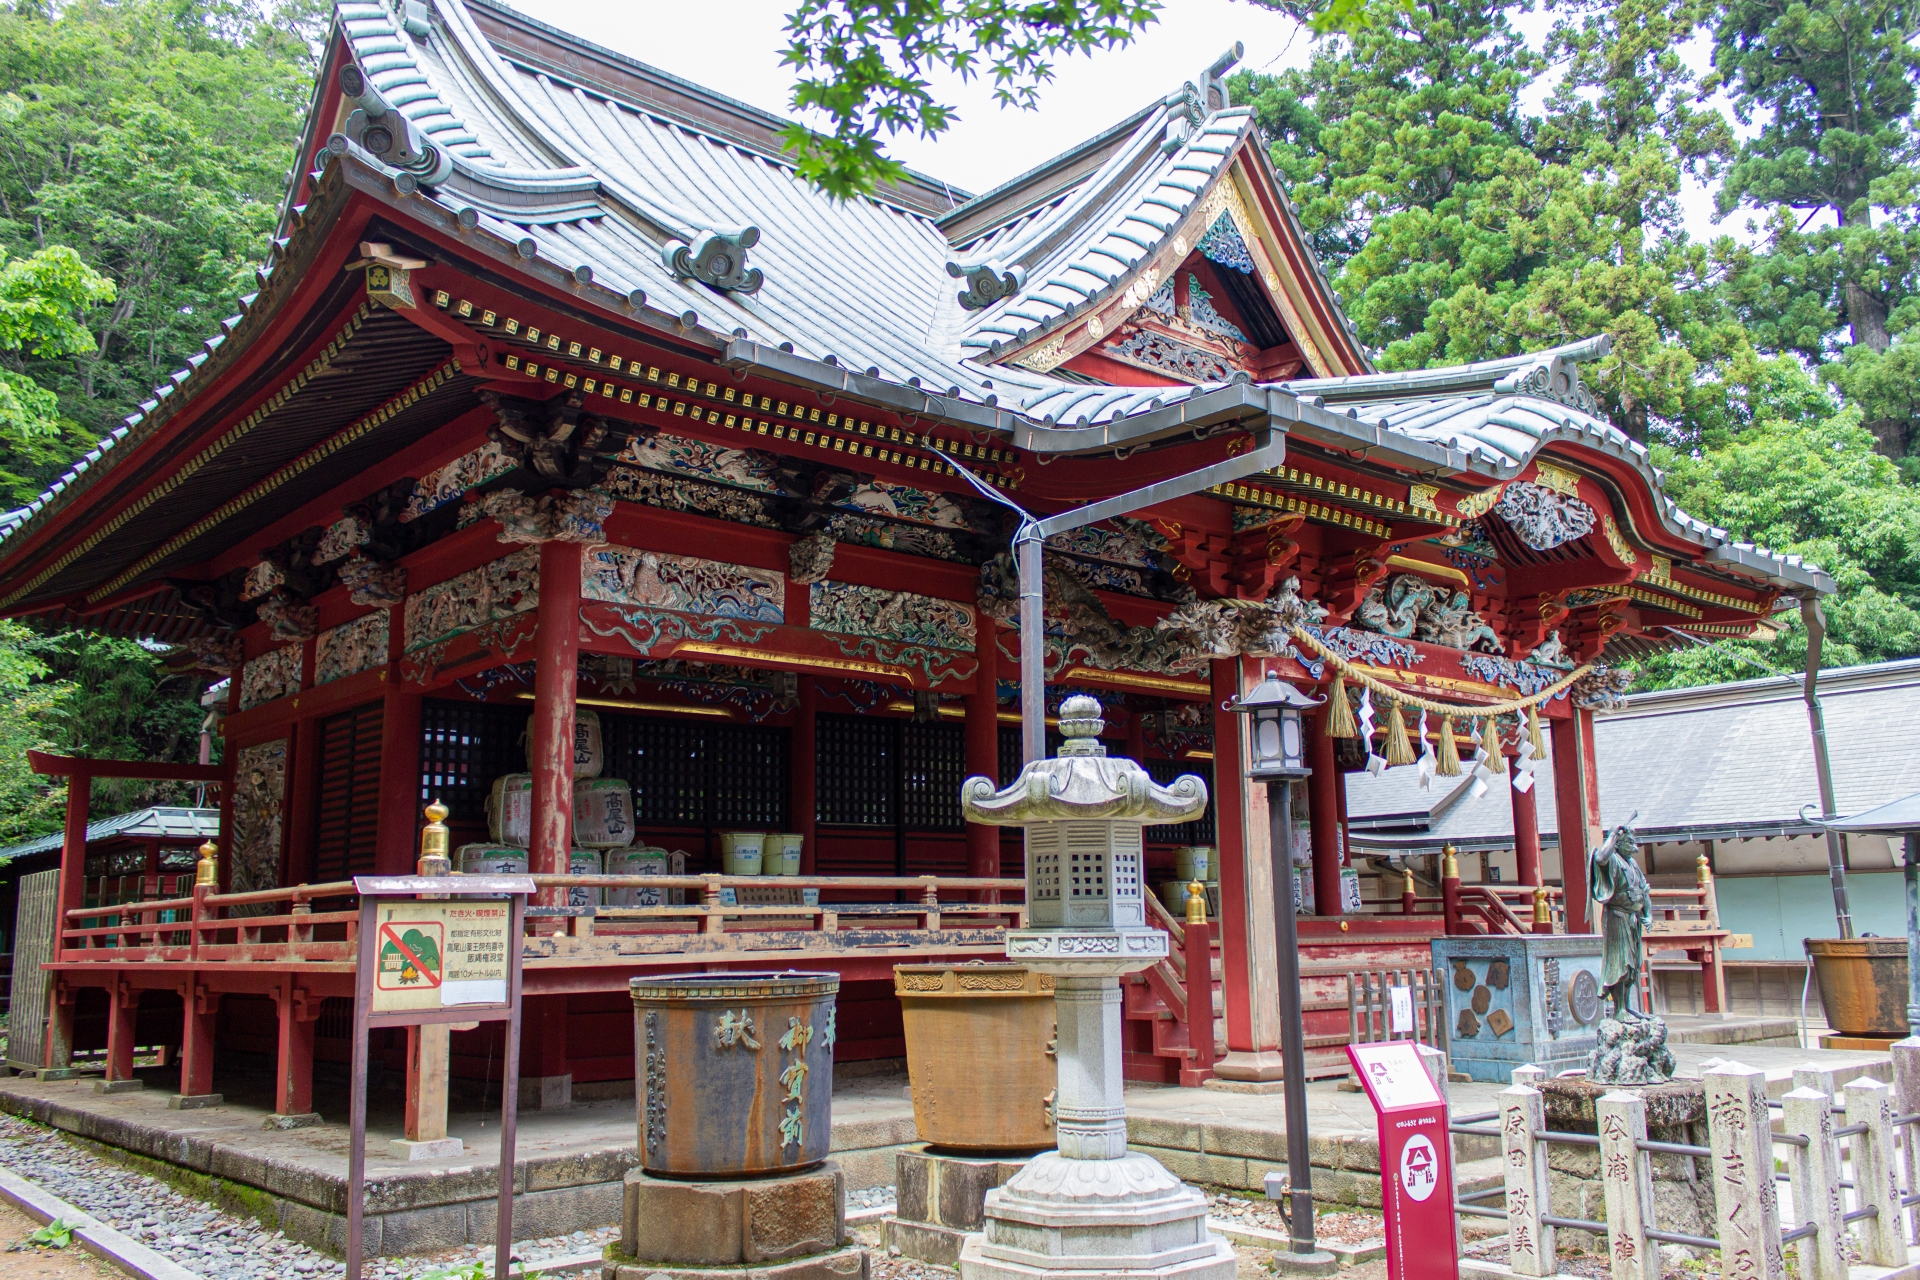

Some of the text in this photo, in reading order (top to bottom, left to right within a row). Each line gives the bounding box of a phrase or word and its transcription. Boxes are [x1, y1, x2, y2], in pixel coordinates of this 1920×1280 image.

[450, 909, 505, 917] たき火・喫煙禁止
